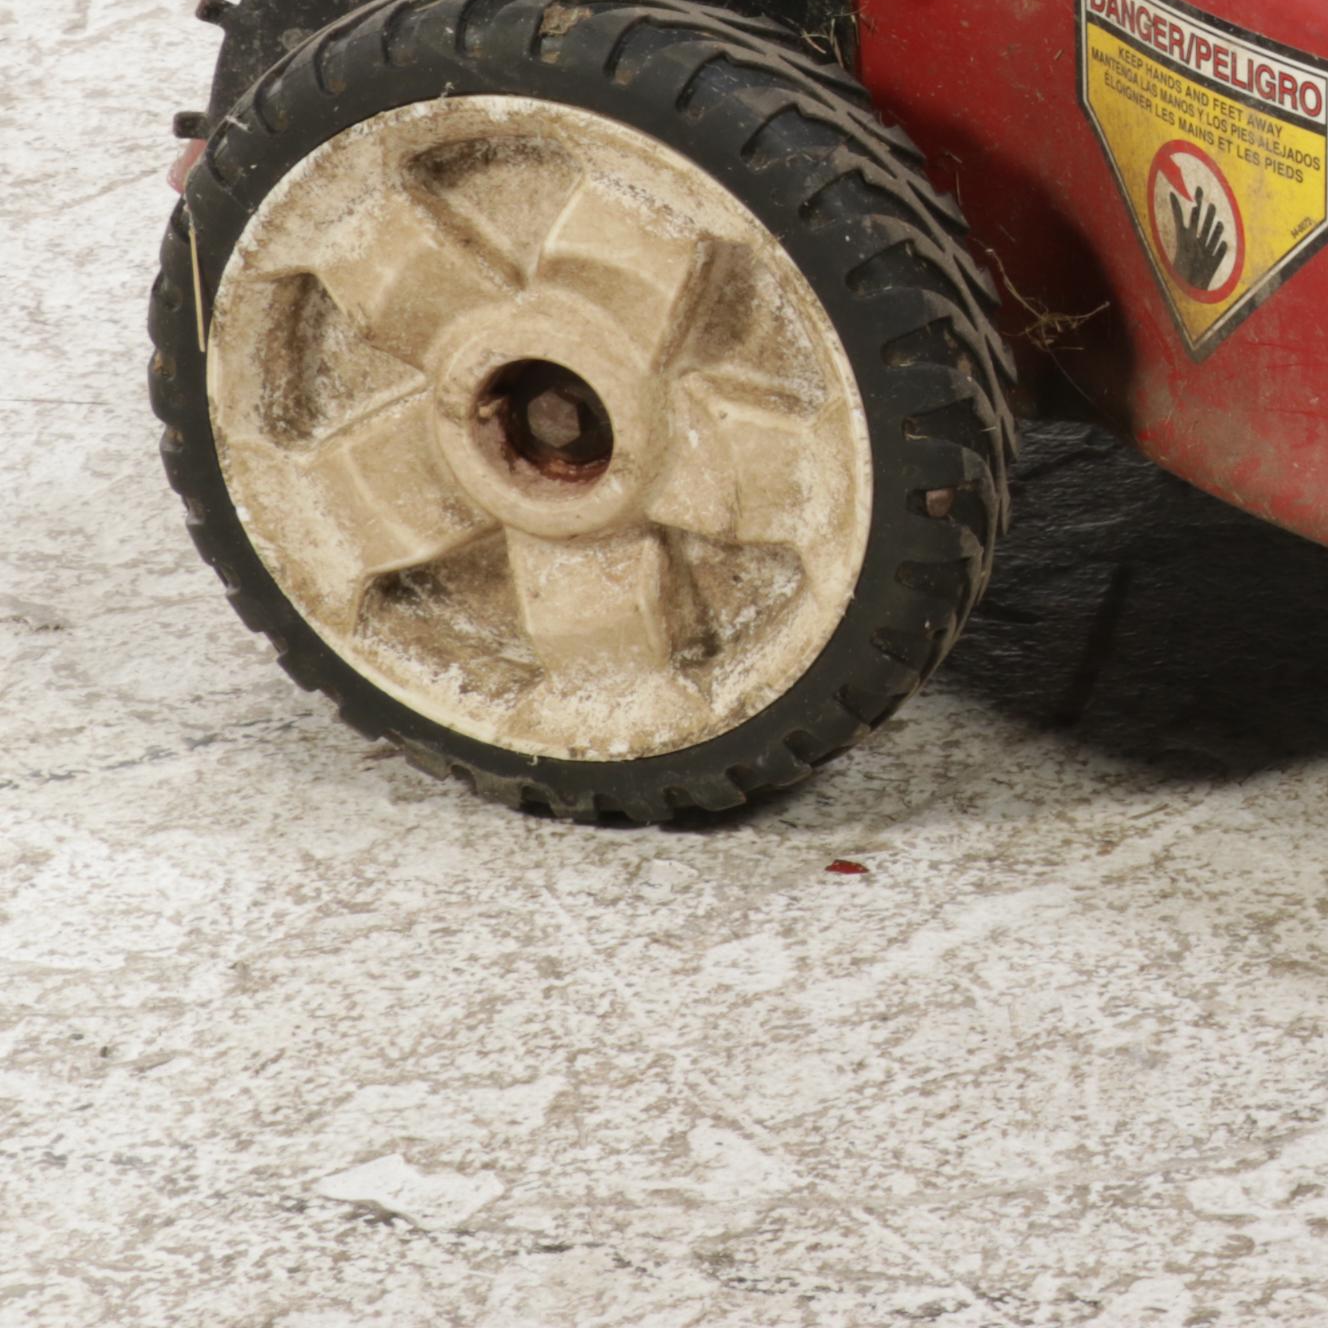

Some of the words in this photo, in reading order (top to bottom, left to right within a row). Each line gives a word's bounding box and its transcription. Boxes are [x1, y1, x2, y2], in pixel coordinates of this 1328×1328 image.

[1091, 45, 1138, 86] MANTENGA
[1140, 76, 1157, 98] LAS
[1159, 87, 1195, 119] MANOS
[1205, 111, 1228, 135] LOS
[1230, 122, 1254, 145] PIES
[1258, 133, 1320, 172] ALEJADOS
[1118, 45, 1143, 71] KEEP
[1145, 61, 1182, 95] HANDS
[1185, 83, 1209, 108] AND
[1212, 96, 1243, 123] FEET
[1246, 111, 1283, 140] AWAY
[1155, 103, 1175, 127] LES
[1178, 115, 1214, 147] MAINS
[1217, 135, 1233, 154] ET
[1236, 143, 1260, 166] LES
[1263, 154, 1303, 184] PIEDS
